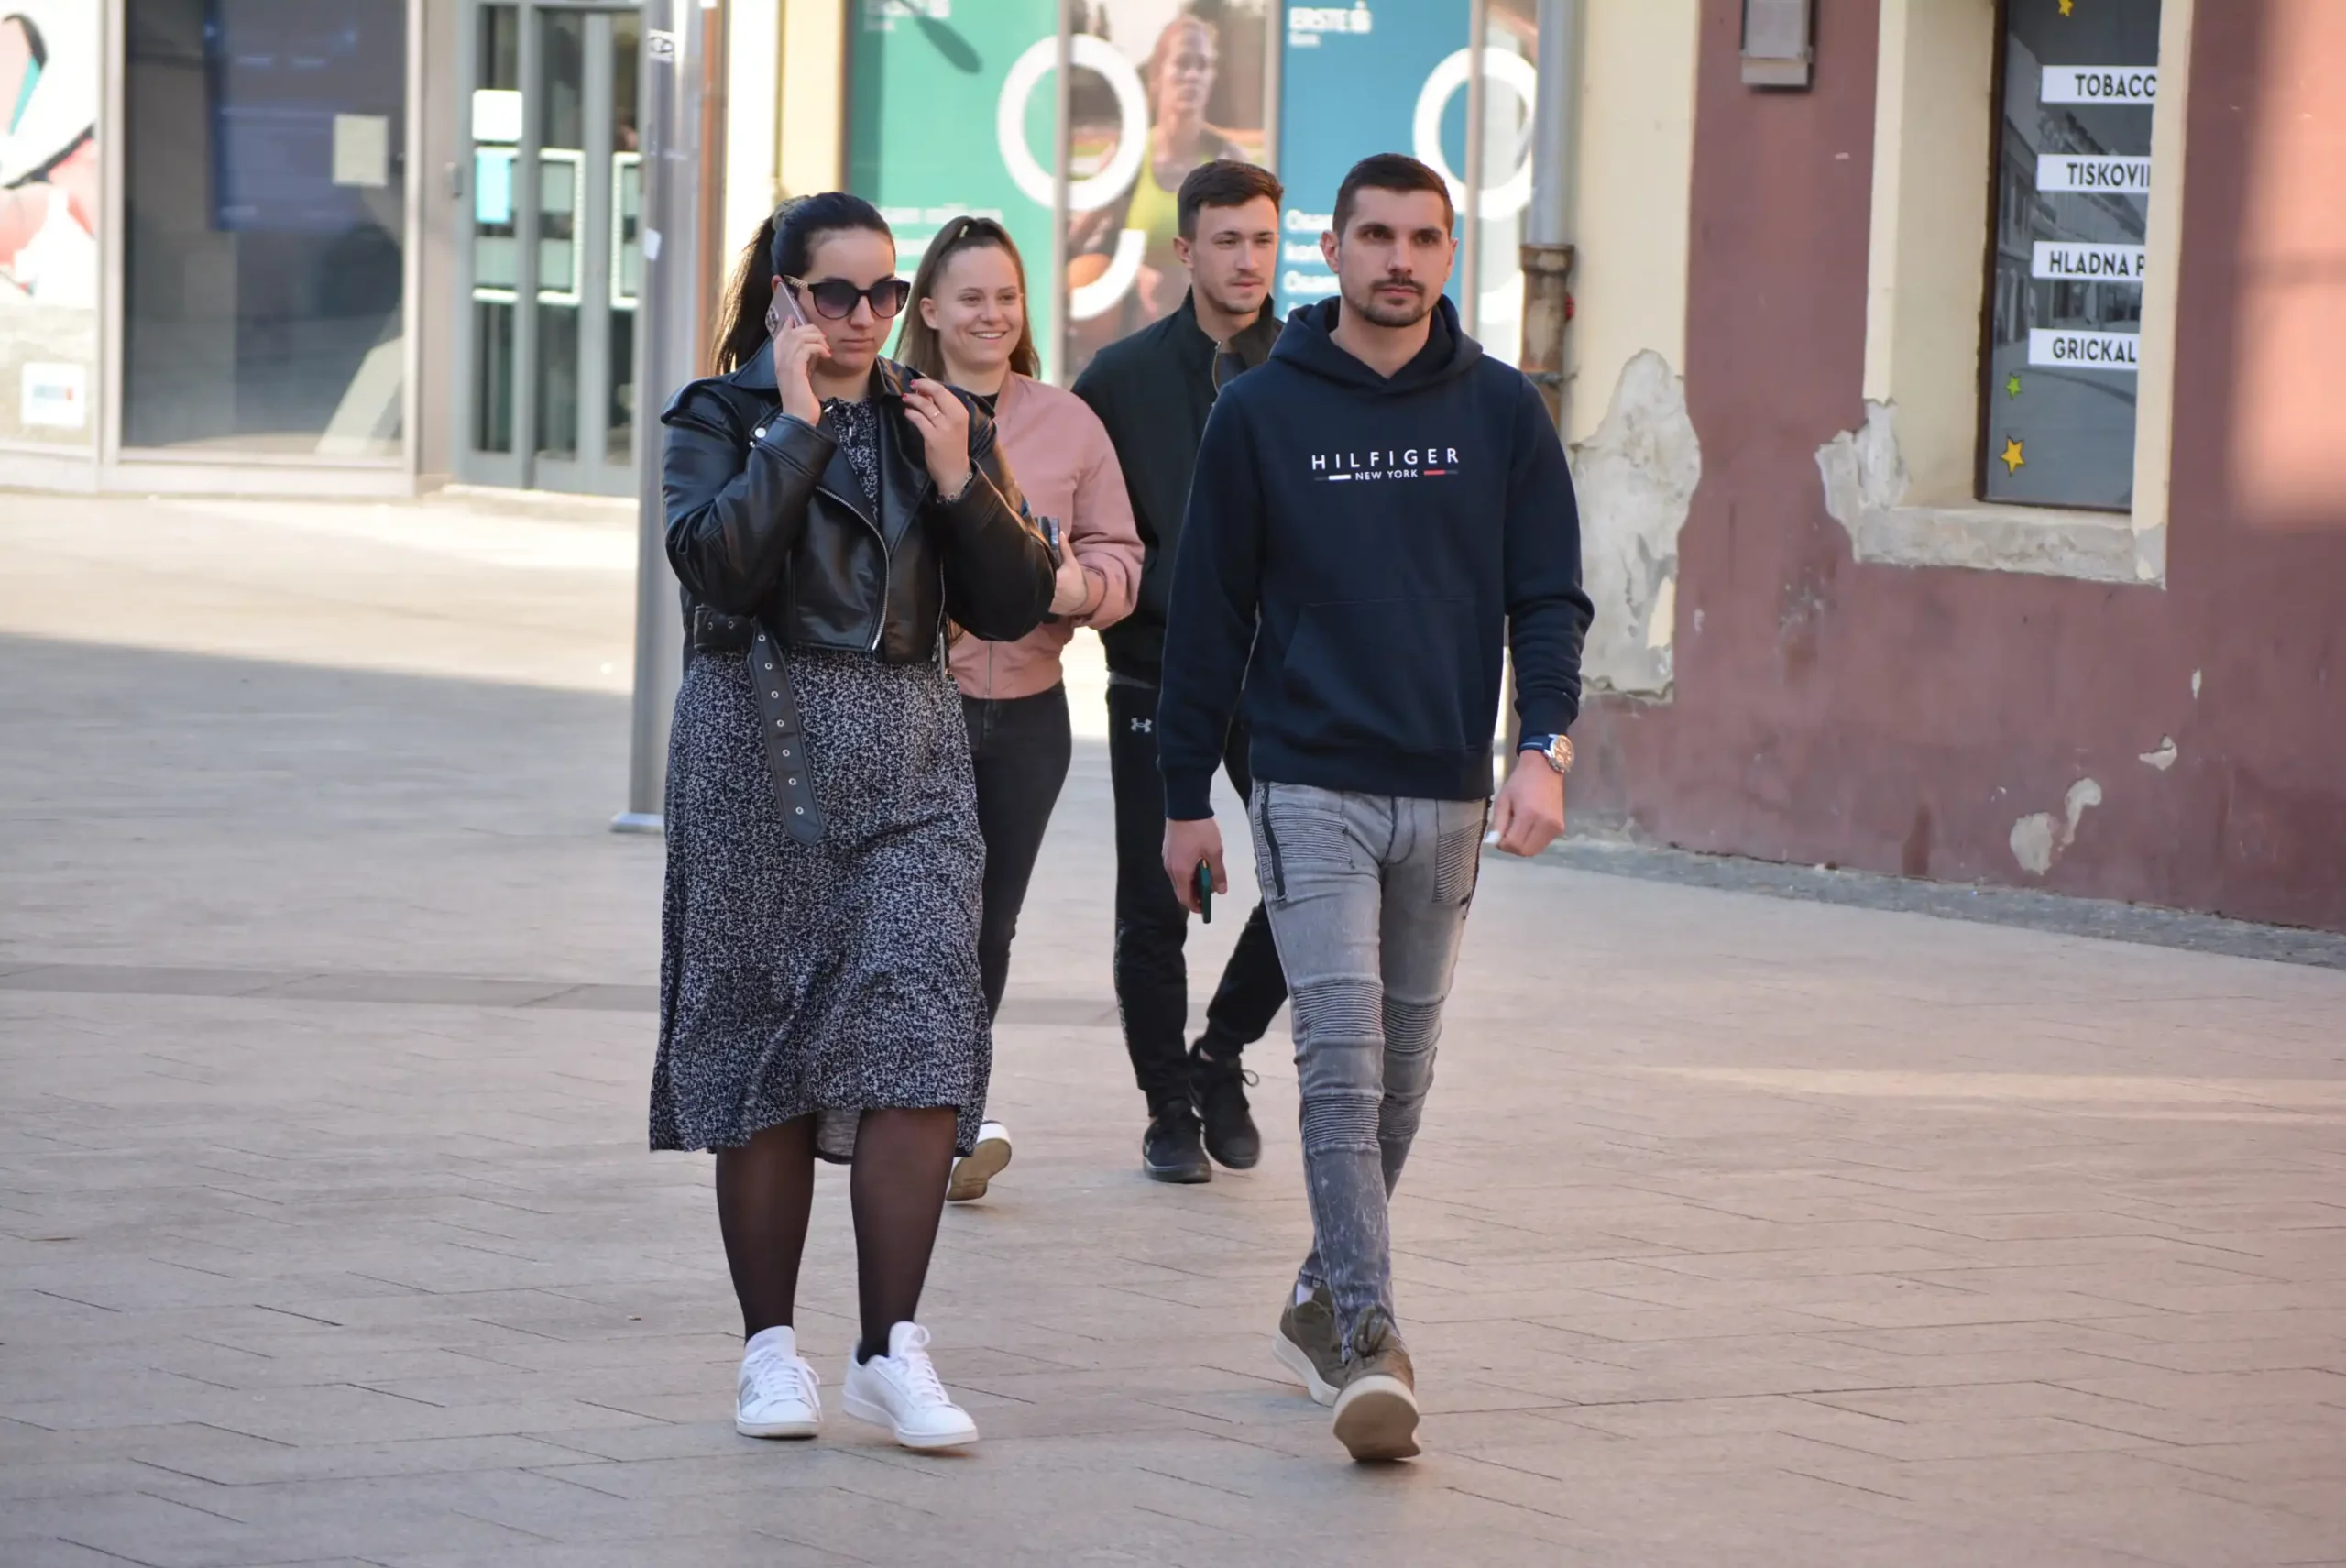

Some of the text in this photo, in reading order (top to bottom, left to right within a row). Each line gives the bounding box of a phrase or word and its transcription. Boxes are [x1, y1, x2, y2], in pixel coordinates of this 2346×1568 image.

[2075, 73, 2157, 97] TOBACC
[2066, 162, 2151, 187] TISKOVI
[2049, 250, 2130, 276] HLADNA
[2053, 337, 2137, 363] GRICKAL
[1311, 447, 1459, 470] HILFIGER
[1355, 469, 1419, 481] NEW YORK
